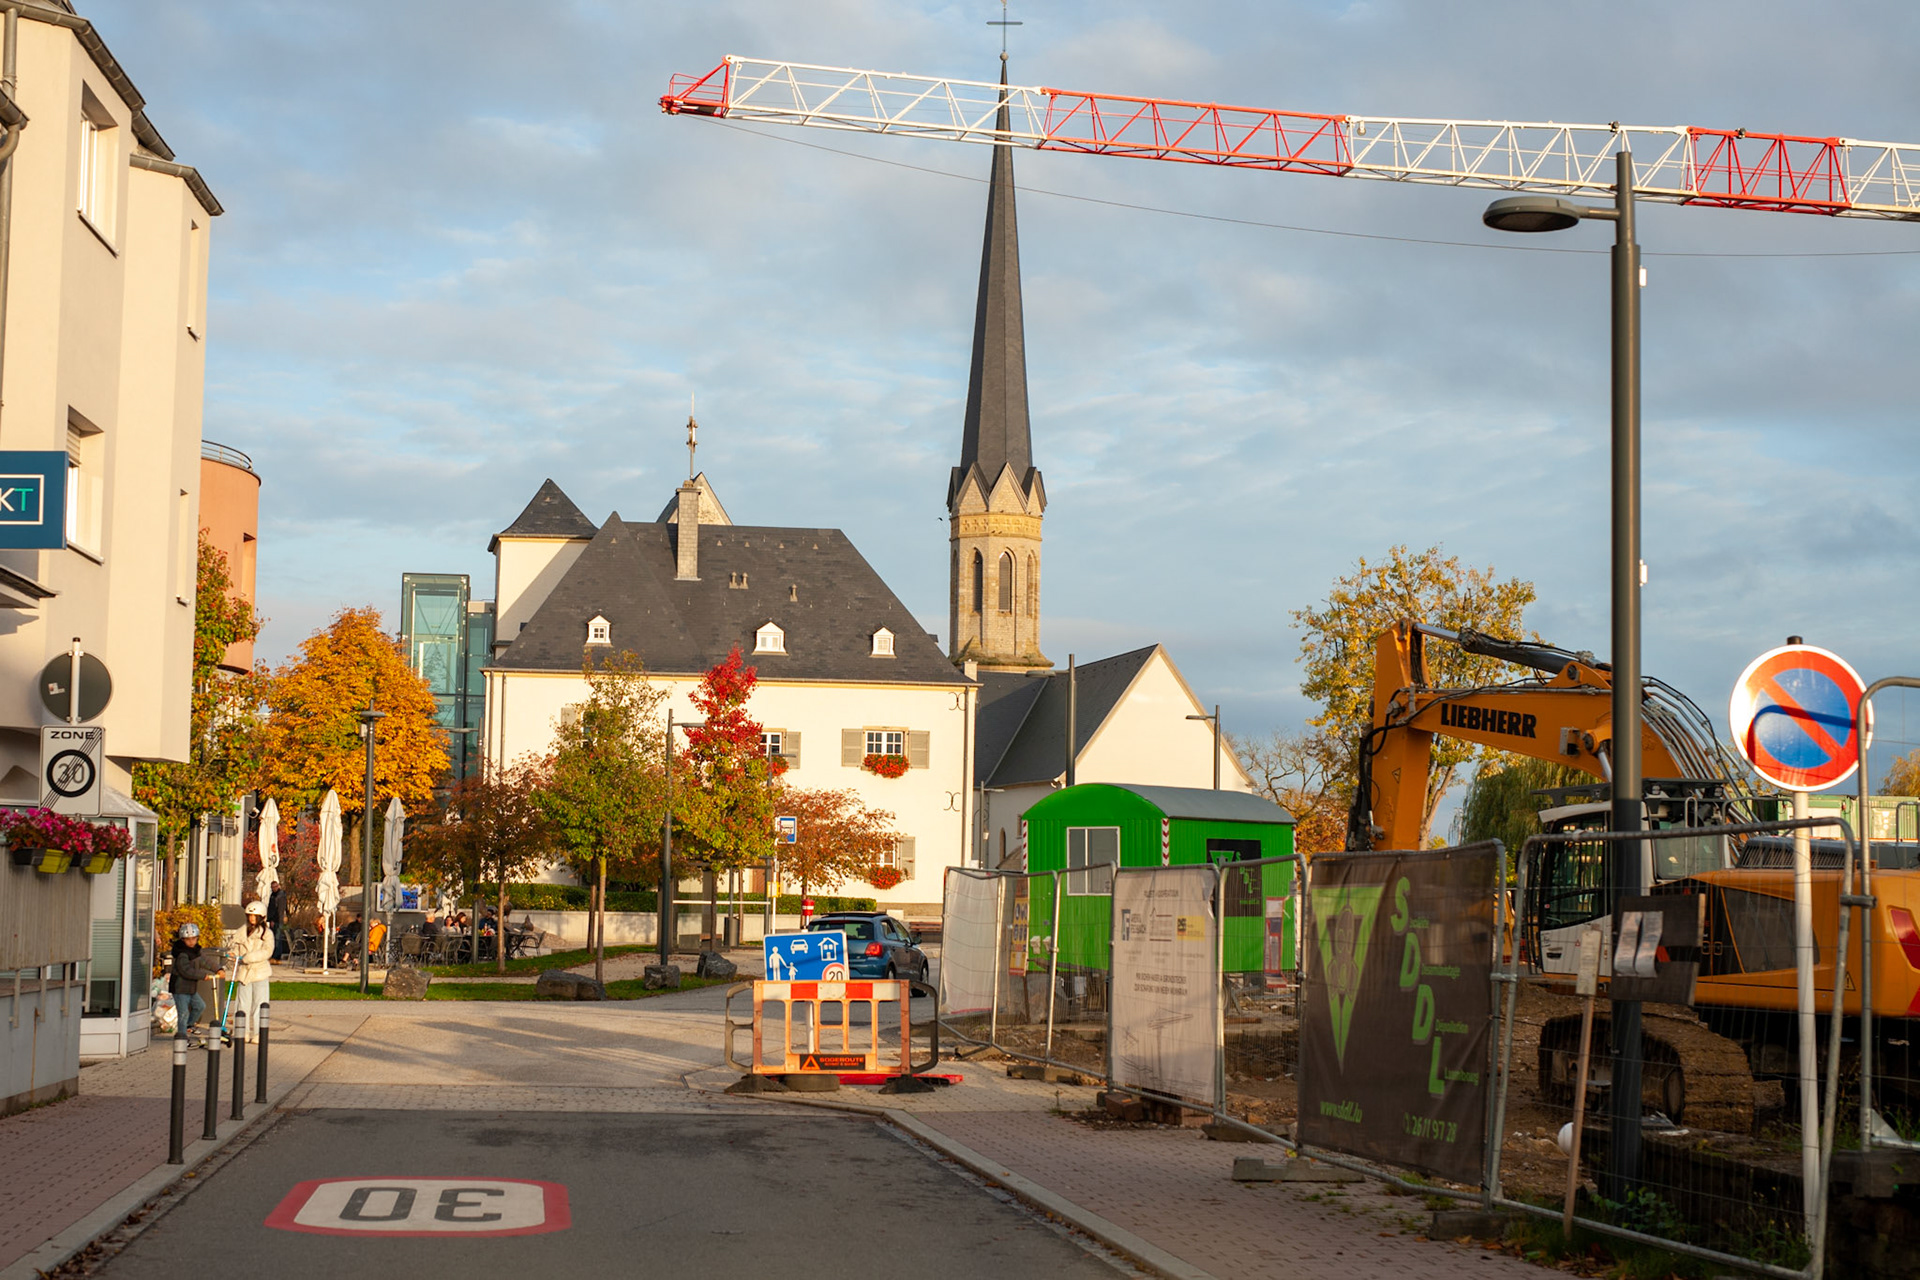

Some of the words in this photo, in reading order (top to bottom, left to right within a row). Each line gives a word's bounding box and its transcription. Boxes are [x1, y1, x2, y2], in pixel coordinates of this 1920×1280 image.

[1440, 703, 1537, 738] LIEBHERR
[50, 731, 95, 739] ZONE
[58, 763, 85, 784] 30
[829, 971, 843, 981] 20
[339, 1186, 505, 1223] 30
